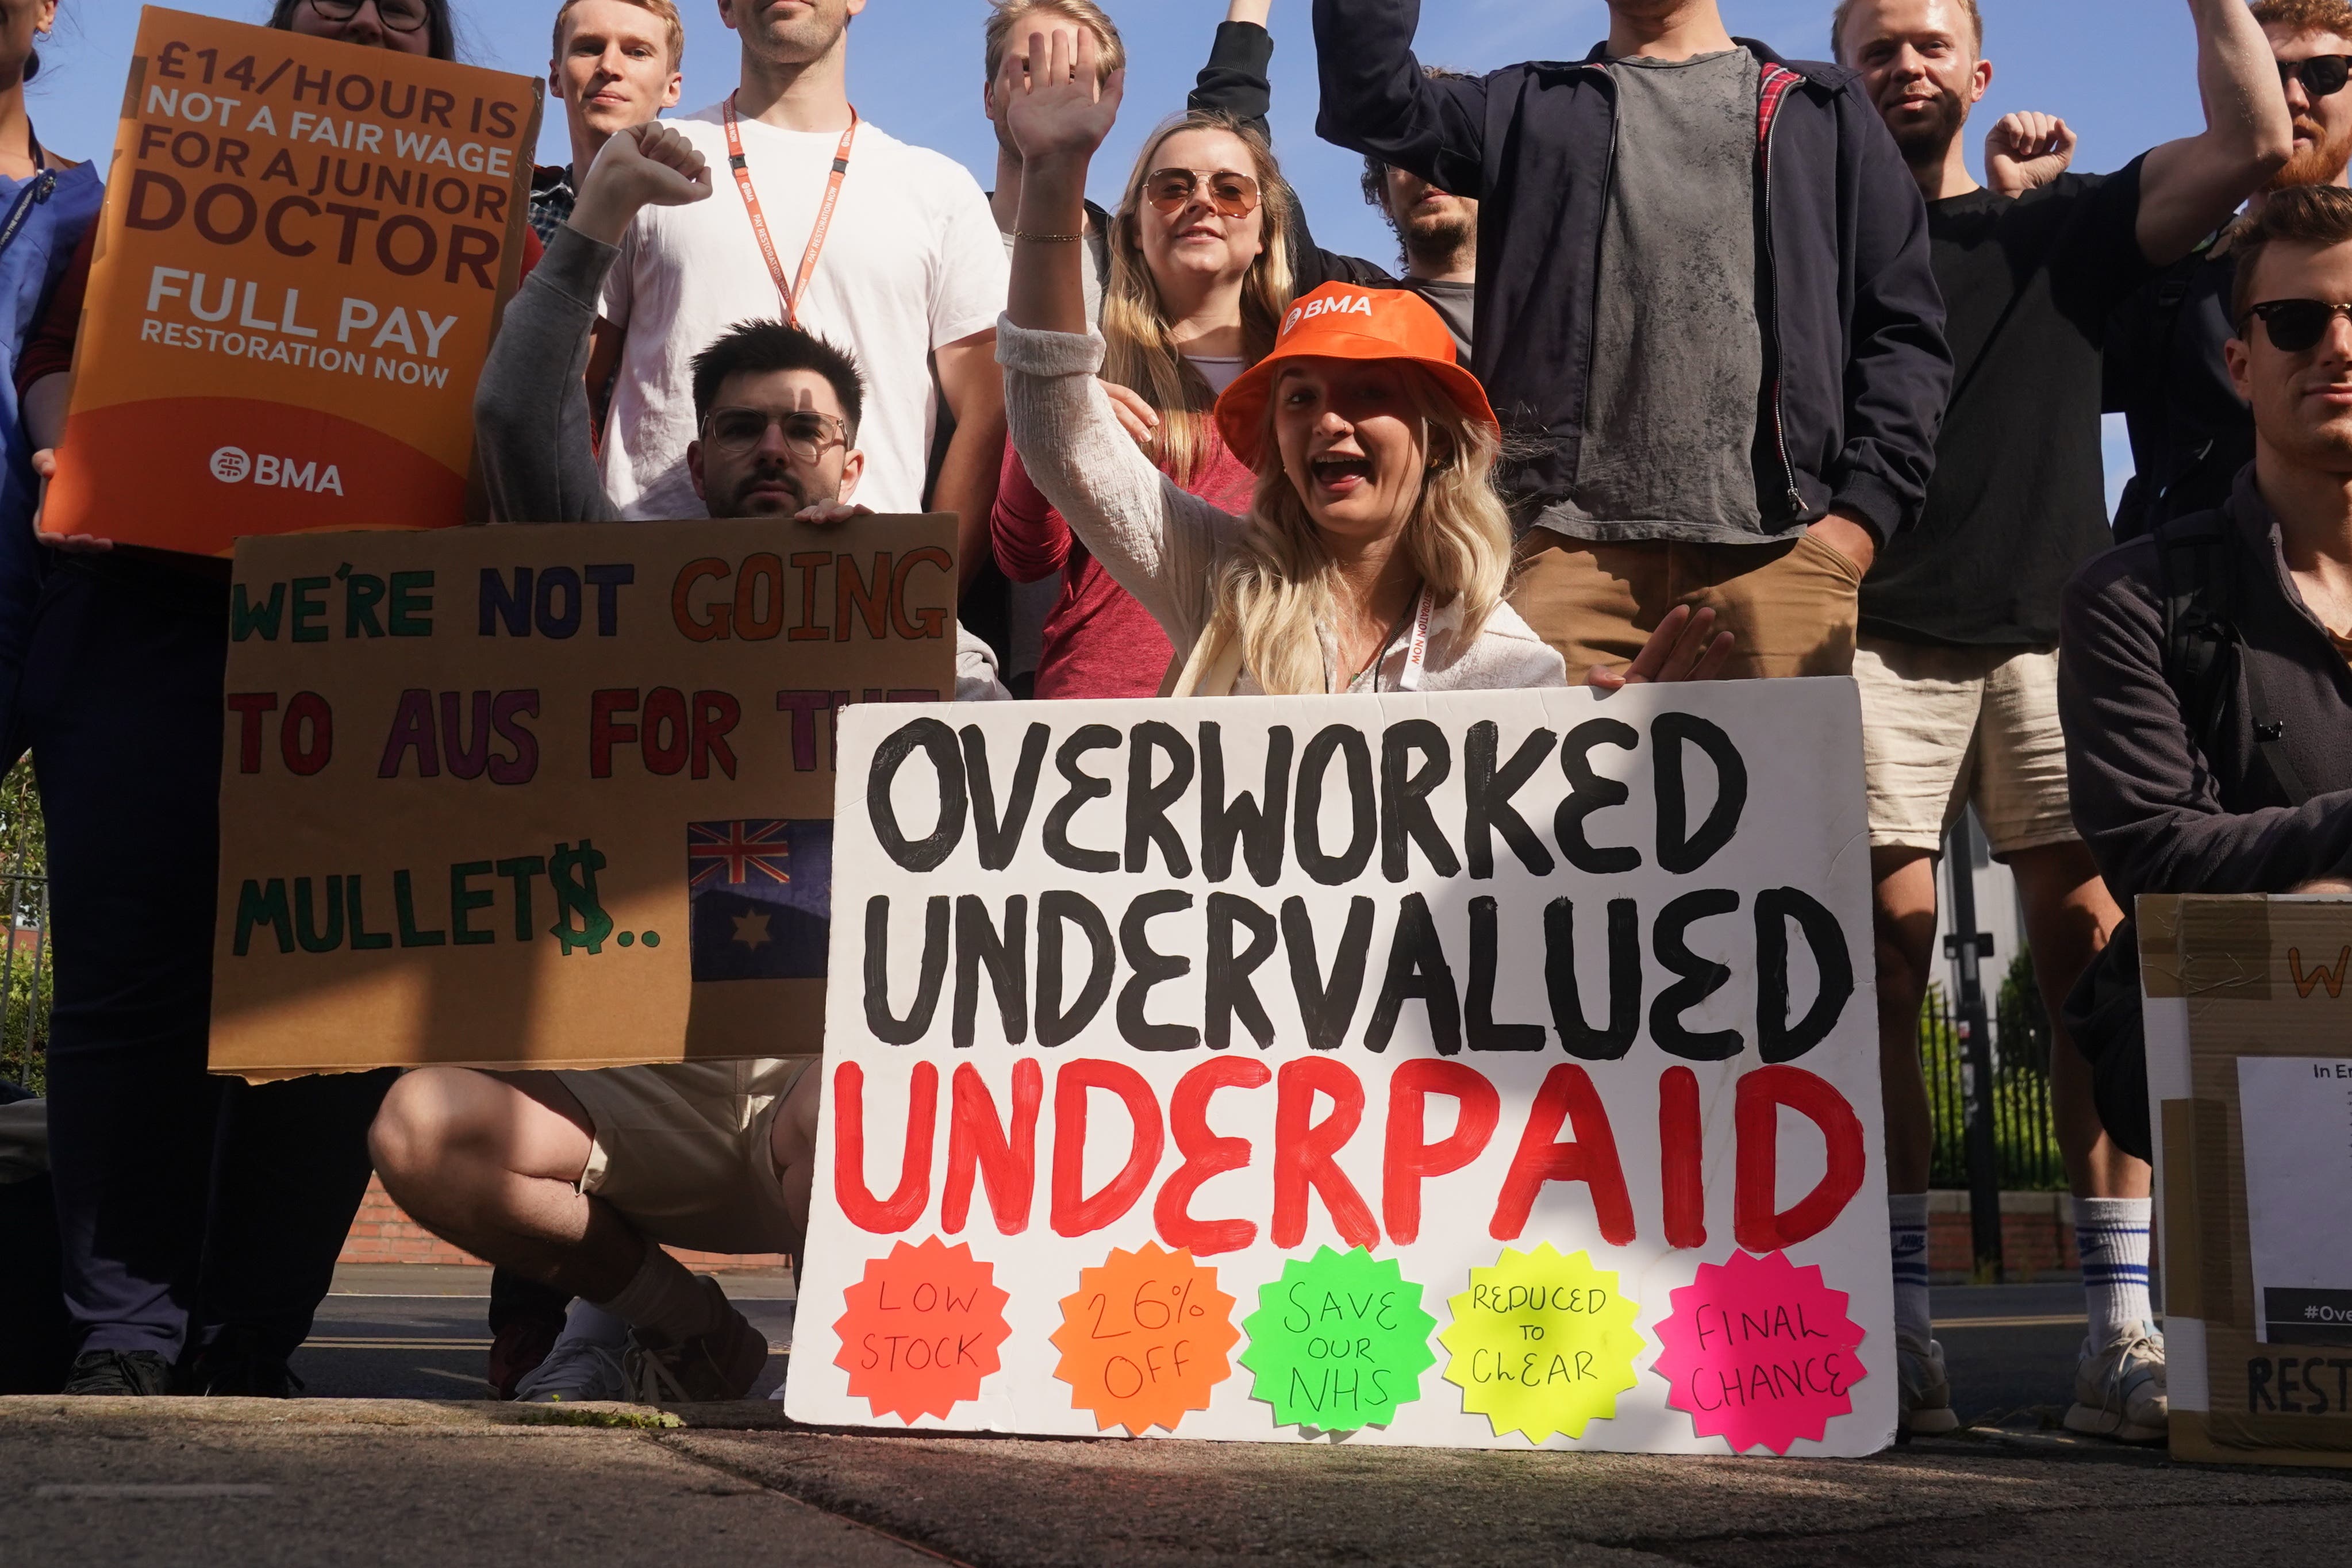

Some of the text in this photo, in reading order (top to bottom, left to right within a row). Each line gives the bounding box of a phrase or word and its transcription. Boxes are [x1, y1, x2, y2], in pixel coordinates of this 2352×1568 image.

[157, 41, 517, 139] £14/HOUR IS
[147, 85, 512, 178] NOT A FAIR WAGE
[729, 129, 739, 143] NOW
[138, 124, 507, 223] FOR A JUNIOR
[744, 186, 754, 202] BMA
[125, 168, 500, 290] DOCTOR
[807, 186, 837, 263] PAY RESTORATION NOW
[753, 214, 790, 299] PAY RESTORATION NOW
[146, 266, 458, 358] FULL PAY
[1303, 295, 1372, 320] BMA
[141, 319, 449, 389] RESTORATION NOW
[253, 454, 344, 496] BMA
[232, 546, 954, 643] WE'RE NOT GOING
[1412, 639, 1423, 664] NOW
[228, 691, 332, 776] TO
[378, 689, 540, 786] AUS
[589, 686, 741, 781] FOR
[867, 712, 1748, 887] OVERWORKED
[863, 886, 1854, 1063] UNDERVALUED
[2313, 1064, 2330, 1078] In
[833, 1058, 1866, 1256] UNDERPAID
[879, 1281, 978, 1313] LOW
[1087, 1278, 1204, 1339] 26%
[1284, 1281, 1398, 1333] SAVE
[1473, 1284, 1607, 1314] REDUCED
[862, 1332, 983, 1371] STOCK
[1308, 1337, 1375, 1363] OUR
[1519, 1324, 1544, 1341] TO
[1696, 1303, 1828, 1351] FINAL
[1105, 1340, 1190, 1398] OFF
[1289, 1367, 1391, 1412] NHS
[1692, 1353, 1848, 1411] CHANCE
[2247, 1356, 2352, 1415] REST
